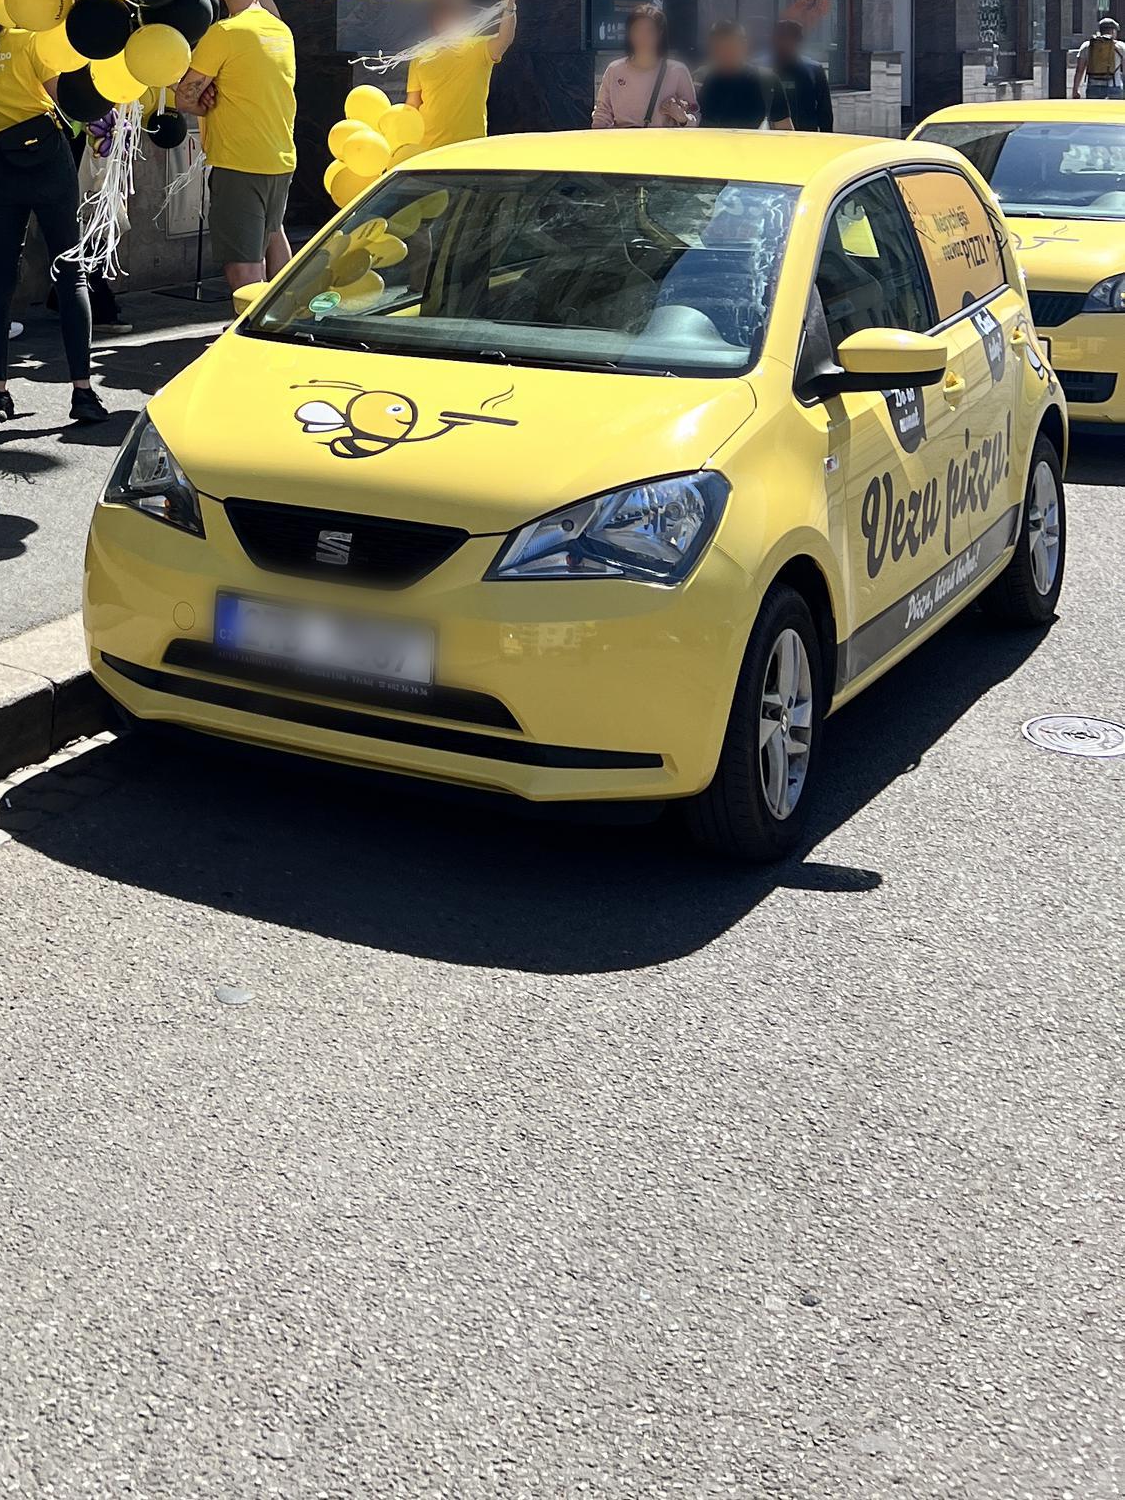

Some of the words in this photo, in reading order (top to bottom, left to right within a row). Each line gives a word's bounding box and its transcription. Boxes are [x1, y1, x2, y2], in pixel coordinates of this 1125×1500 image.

[961, 233, 990, 270] PIZZY
[861, 471, 942, 579] Vezu
[943, 409, 1012, 556] pizzu!
